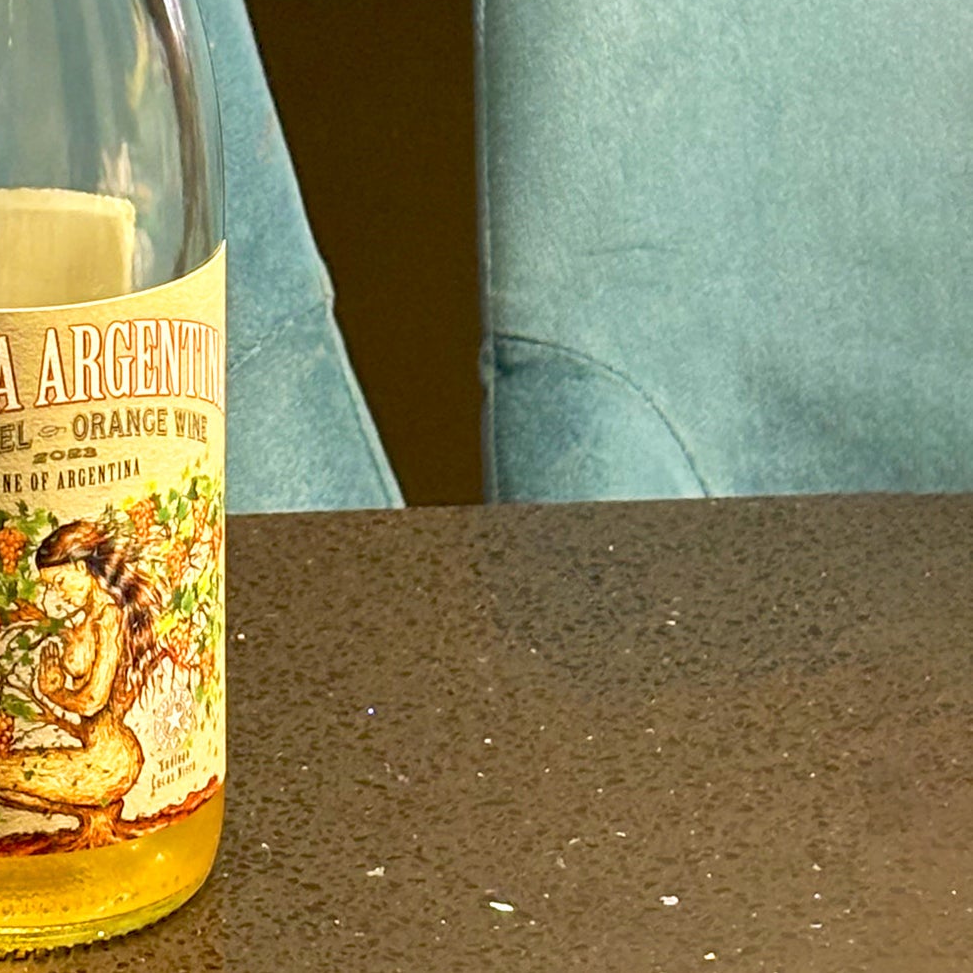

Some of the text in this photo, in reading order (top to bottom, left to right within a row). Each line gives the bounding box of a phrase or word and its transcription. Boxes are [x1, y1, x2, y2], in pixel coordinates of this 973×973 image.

[72, 408, 168, 442] ORANGE
[174, 410, 208, 443] WINE
[30, 472, 49, 492] OF
[57, 457, 140, 490] ARGENTINA
